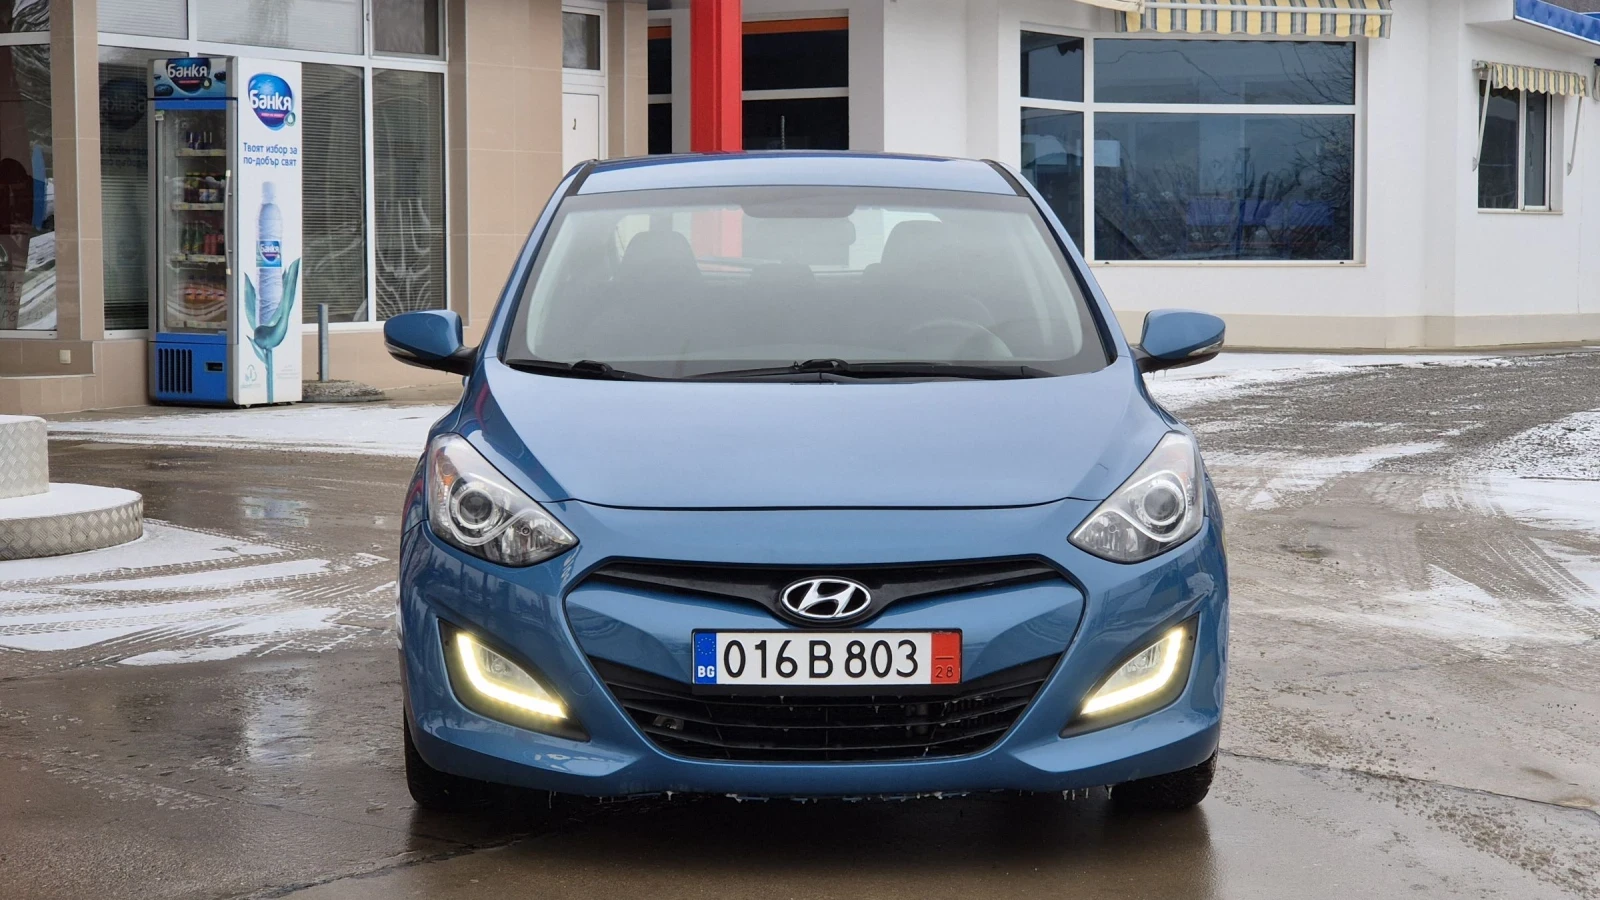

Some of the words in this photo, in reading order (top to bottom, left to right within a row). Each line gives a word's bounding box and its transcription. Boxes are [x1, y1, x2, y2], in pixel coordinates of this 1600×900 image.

[243, 142, 264, 152] Твоят
[266, 144, 288, 156] избор
[289, 147, 298, 155] за
[243, 156, 279, 168] по-добър
[281, 158, 297, 166] свят
[723, 639, 799, 679] 016
[844, 639, 919, 679] 803
[697, 665, 716, 678] BG
[935, 665, 955, 679] 28
